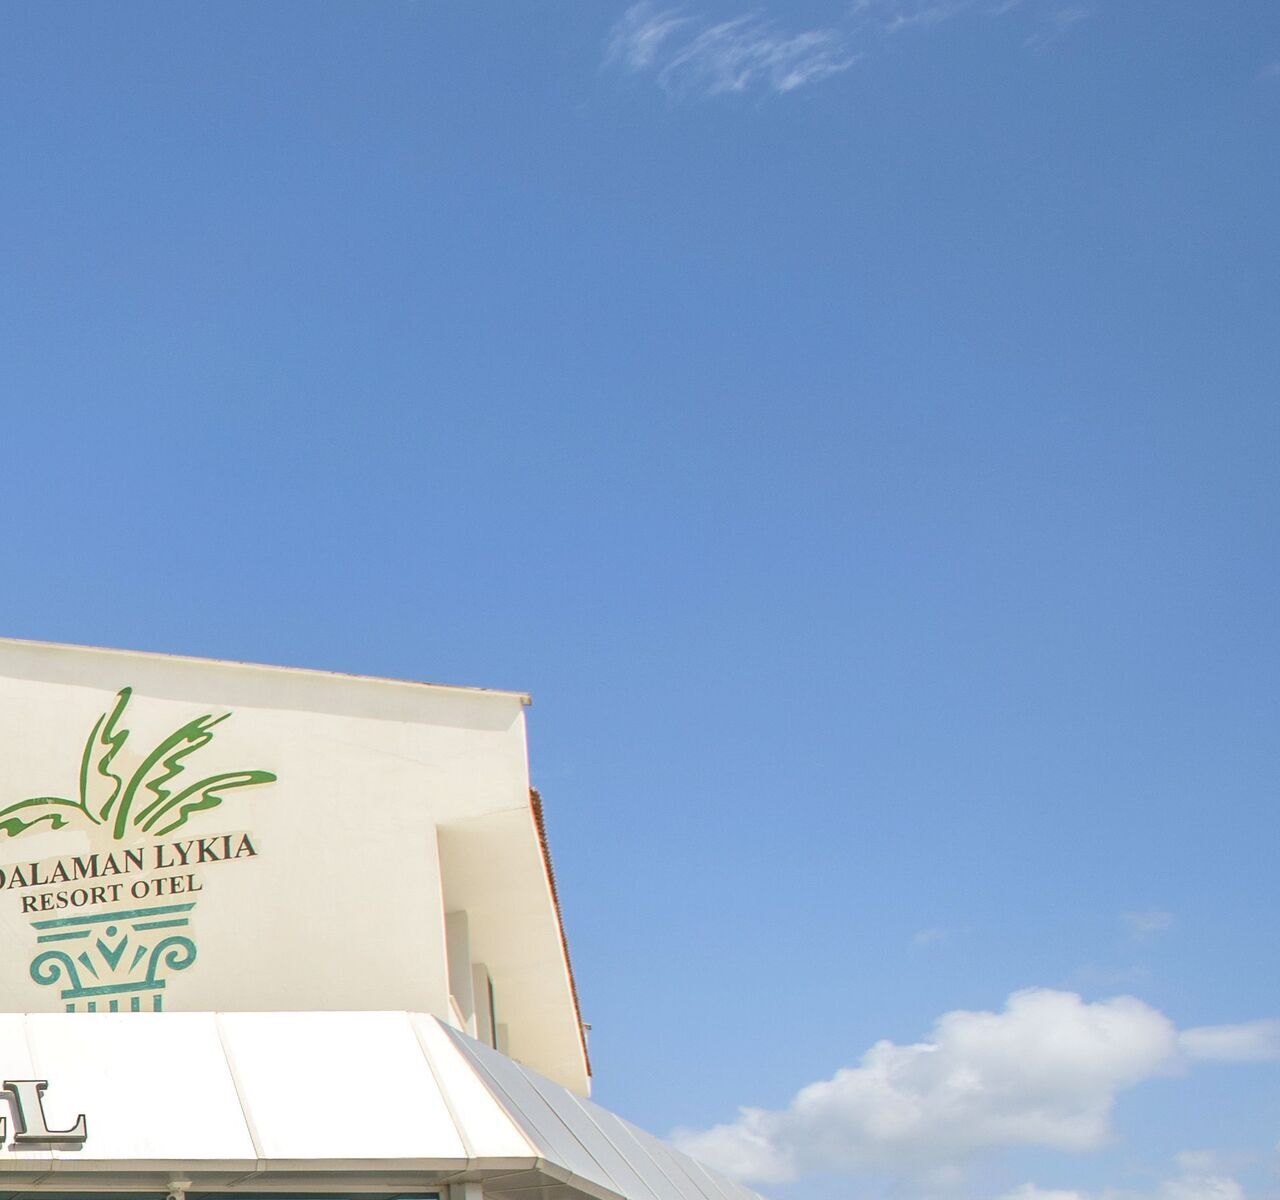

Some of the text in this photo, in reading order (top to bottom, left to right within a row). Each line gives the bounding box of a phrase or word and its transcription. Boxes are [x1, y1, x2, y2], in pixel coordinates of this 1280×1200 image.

[153, 833, 259, 870] LYKIA
[21, 873, 204, 914] RESORT OTEL
